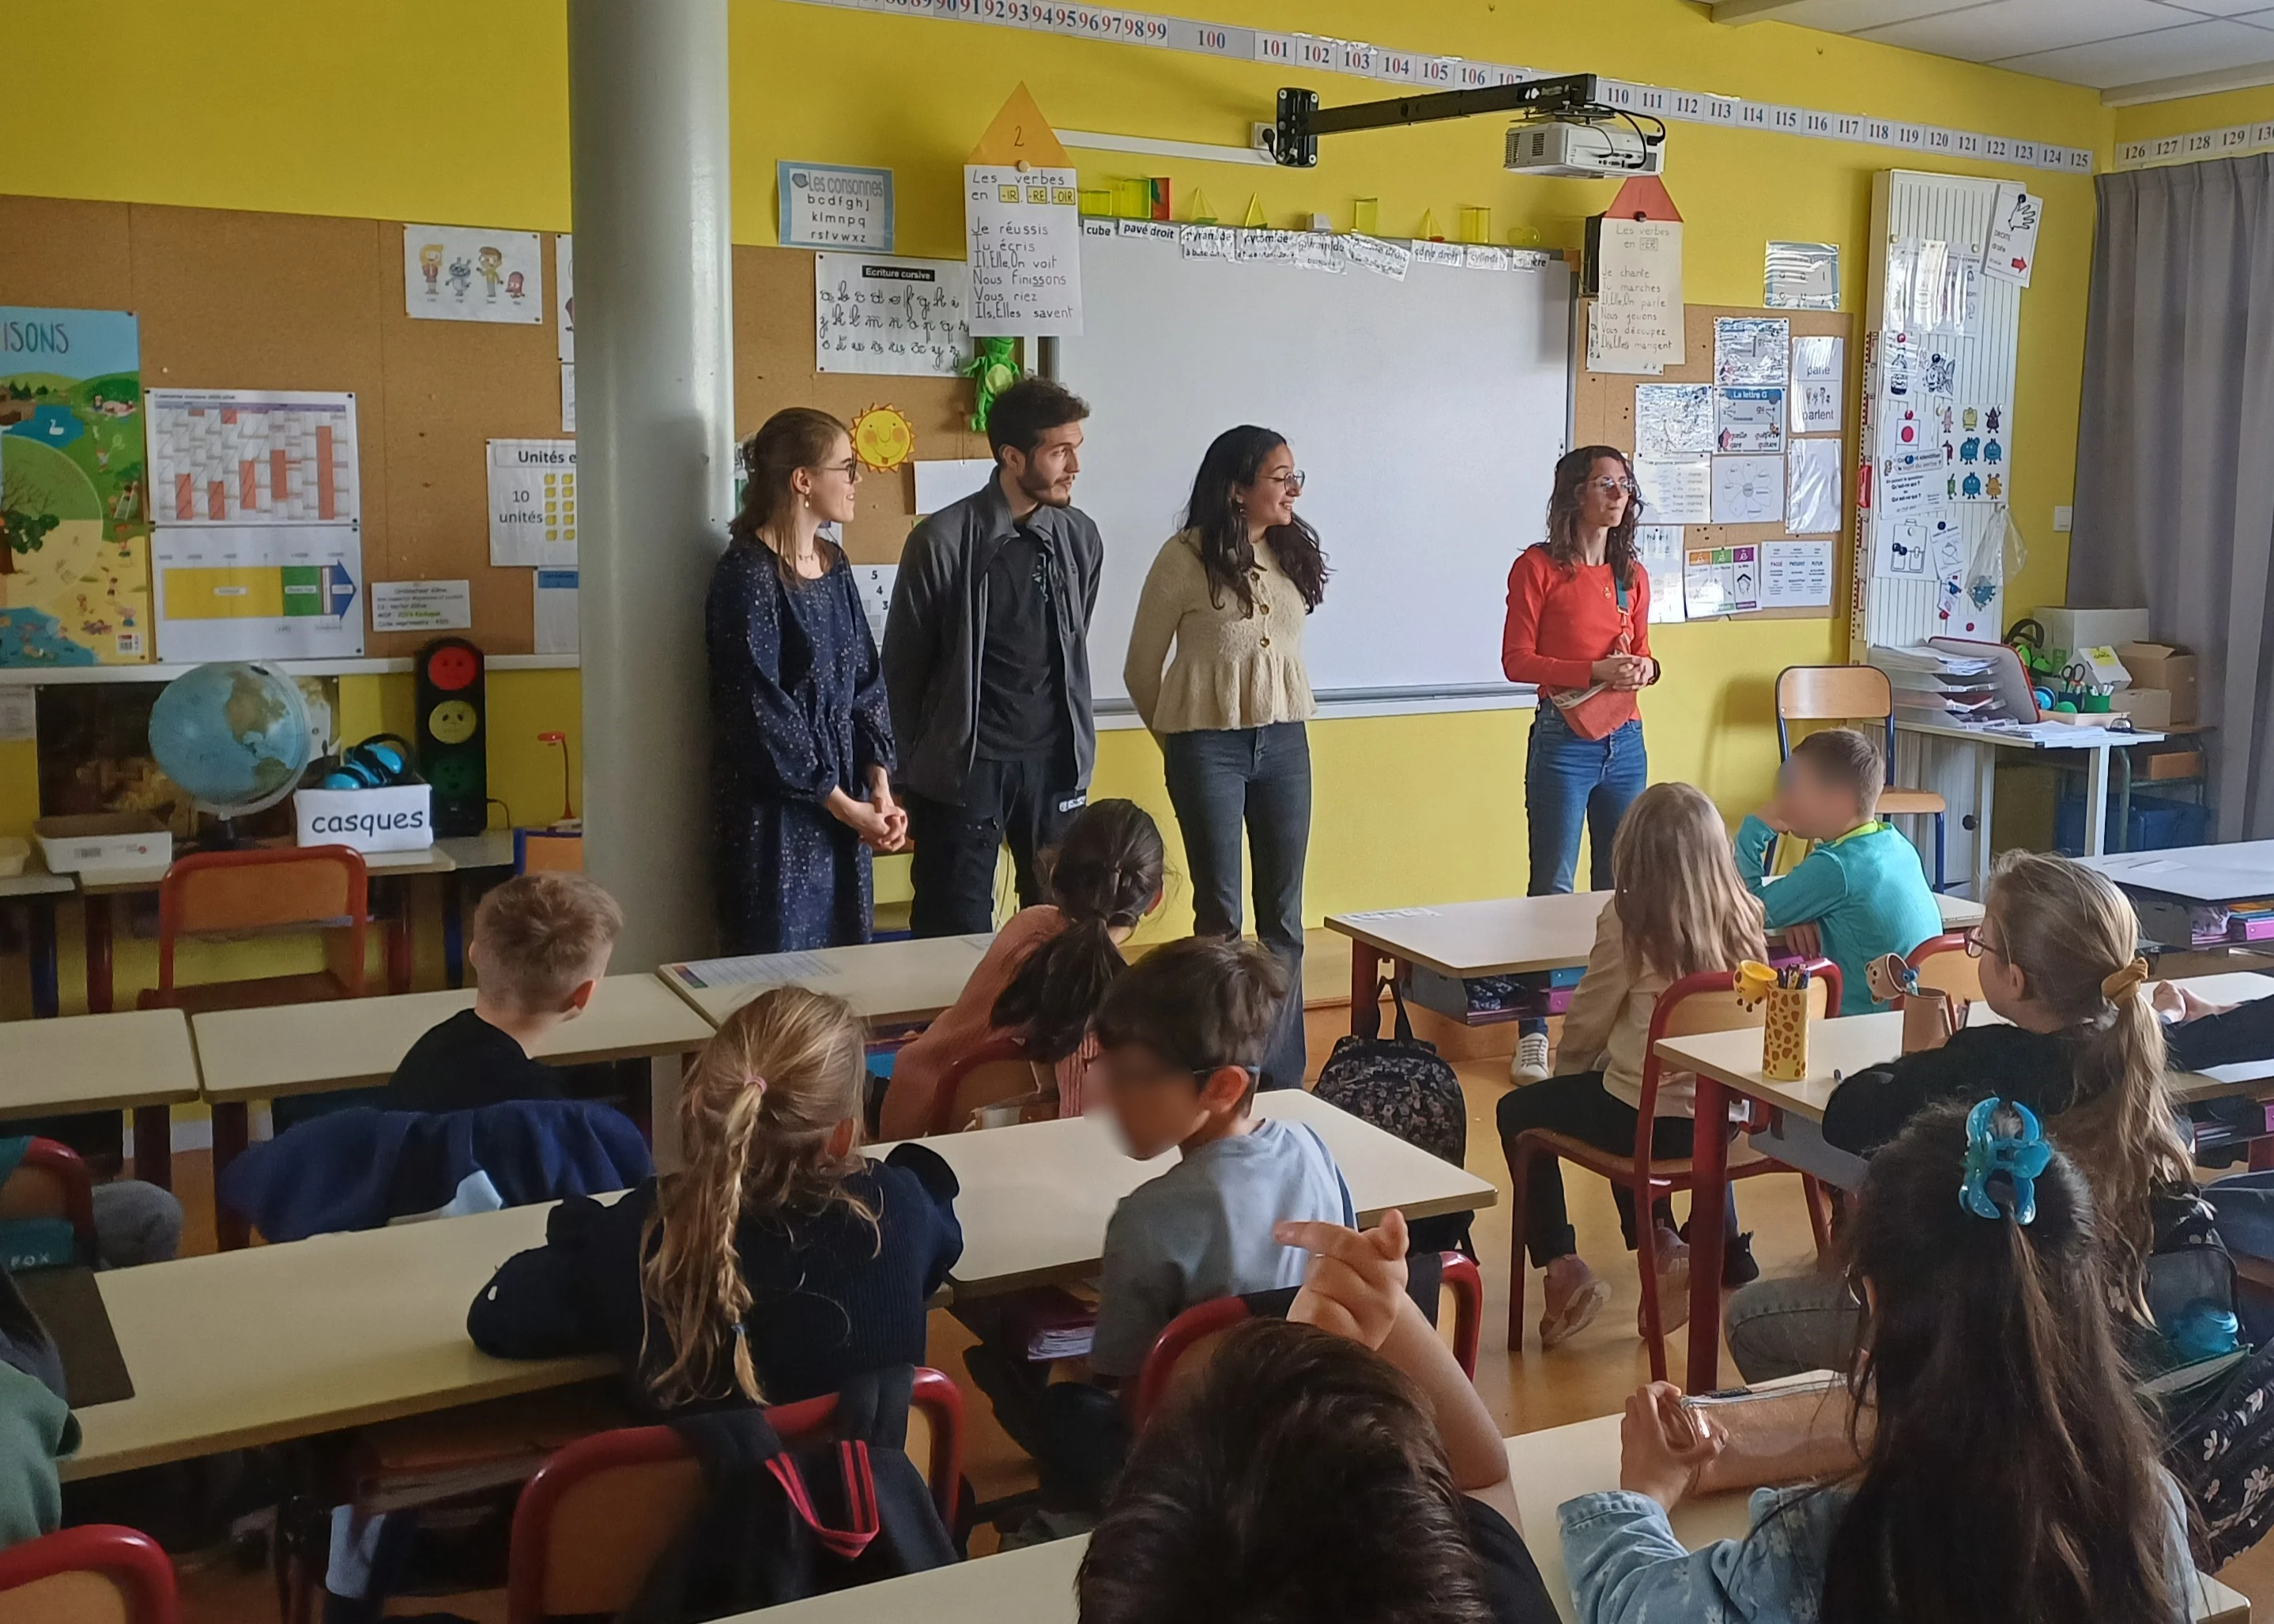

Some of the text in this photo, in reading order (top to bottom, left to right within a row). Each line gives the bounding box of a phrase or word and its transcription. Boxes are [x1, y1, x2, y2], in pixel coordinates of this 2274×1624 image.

[960, 0, 979, 14] 91
[984, 1, 1005, 19] 92
[1009, 3, 1028, 21] 93
[1032, 6, 1053, 24] 94
[1055, 8, 1077, 28] 95
[1079, 12, 1099, 32] 96
[1102, 14, 1122, 35] 97
[1125, 18, 1144, 37] 98
[1147, 21, 1167, 40] 99
[1197, 29, 1225, 49] 100
[1262, 39, 1288, 58] 101
[1304, 44, 1329, 64] 102
[1344, 50, 1371, 70] 103
[1384, 56, 1409, 75] 104
[1424, 62, 1449, 81] 105
[1461, 67, 1485, 85] 106
[1608, 87, 2088, 167] 110 111 112 113 114 115 116 117 118 119 120 121 122 123 124 125
[1014, 126, 1024, 147] 2
[2126, 146, 2145, 160] 126
[2157, 141, 2177, 156] 127
[2189, 136, 2210, 151] 128
[2223, 130, 2245, 147] 129
[973, 169, 1065, 185] Les verbes
[809, 171, 884, 198] Les consonnes
[971, 217, 1048, 235] Je réussis
[1087, 225, 1111, 235] cube
[1124, 224, 1175, 239] pavé droit
[1616, 224, 1670, 236] Les verbes
[971, 234, 1035, 252] Tu écris
[1624, 240, 1635, 249] en
[1033, 254, 1058, 269] voit
[865, 267, 930, 280] Ecriture cursive
[973, 269, 1066, 285] Nous finissons
[1602, 265, 1650, 278] Je chante
[974, 286, 1037, 302] Vous riez
[1620, 284, 1661, 292] marches
[1641, 297, 1666, 308] parle
[1034, 305, 1073, 318] savent
[1601, 307, 1657, 325] Nous jouons
[3, 321, 69, 354] ISONS
[1601, 323, 1666, 339] Vous découpez
[1634, 341, 1673, 354] mangent
[1803, 409, 1834, 420] parlent
[518, 450, 564, 464] Unités
[513, 490, 530, 503] 10
[500, 511, 543, 524] unités
[871, 571, 877, 580] 5
[877, 586, 883, 595] 4
[882, 601, 888, 610] 3
[311, 808, 424, 835] casques
